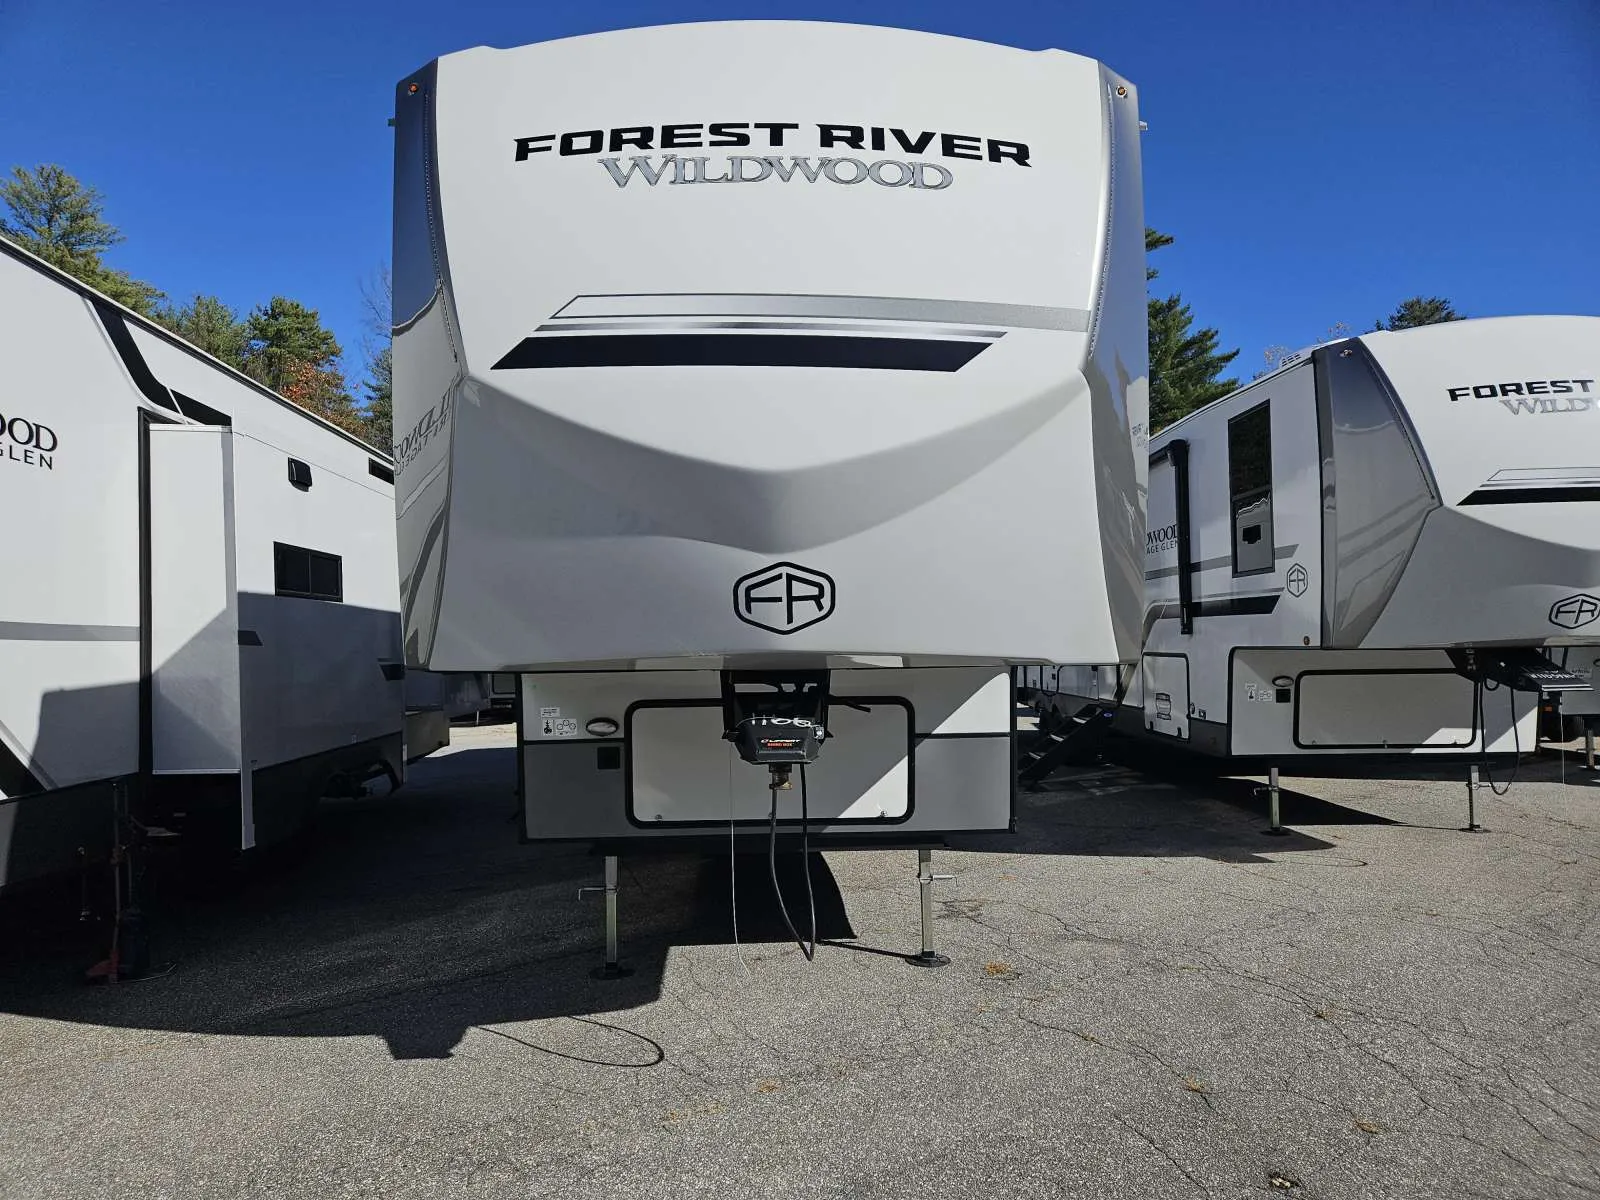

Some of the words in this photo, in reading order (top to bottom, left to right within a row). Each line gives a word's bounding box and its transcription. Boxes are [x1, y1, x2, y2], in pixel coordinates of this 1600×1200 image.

[515, 123, 799, 161] FOREST
[816, 124, 1032, 168] RIVER
[597, 154, 954, 190] WILDWOOD
[1447, 380, 1594, 402] FOREST
[1499, 398, 1597, 416] WILD
[0, 412, 58, 452] OD
[0, 442, 53, 470] LEN
[744, 572, 825, 625] FR
